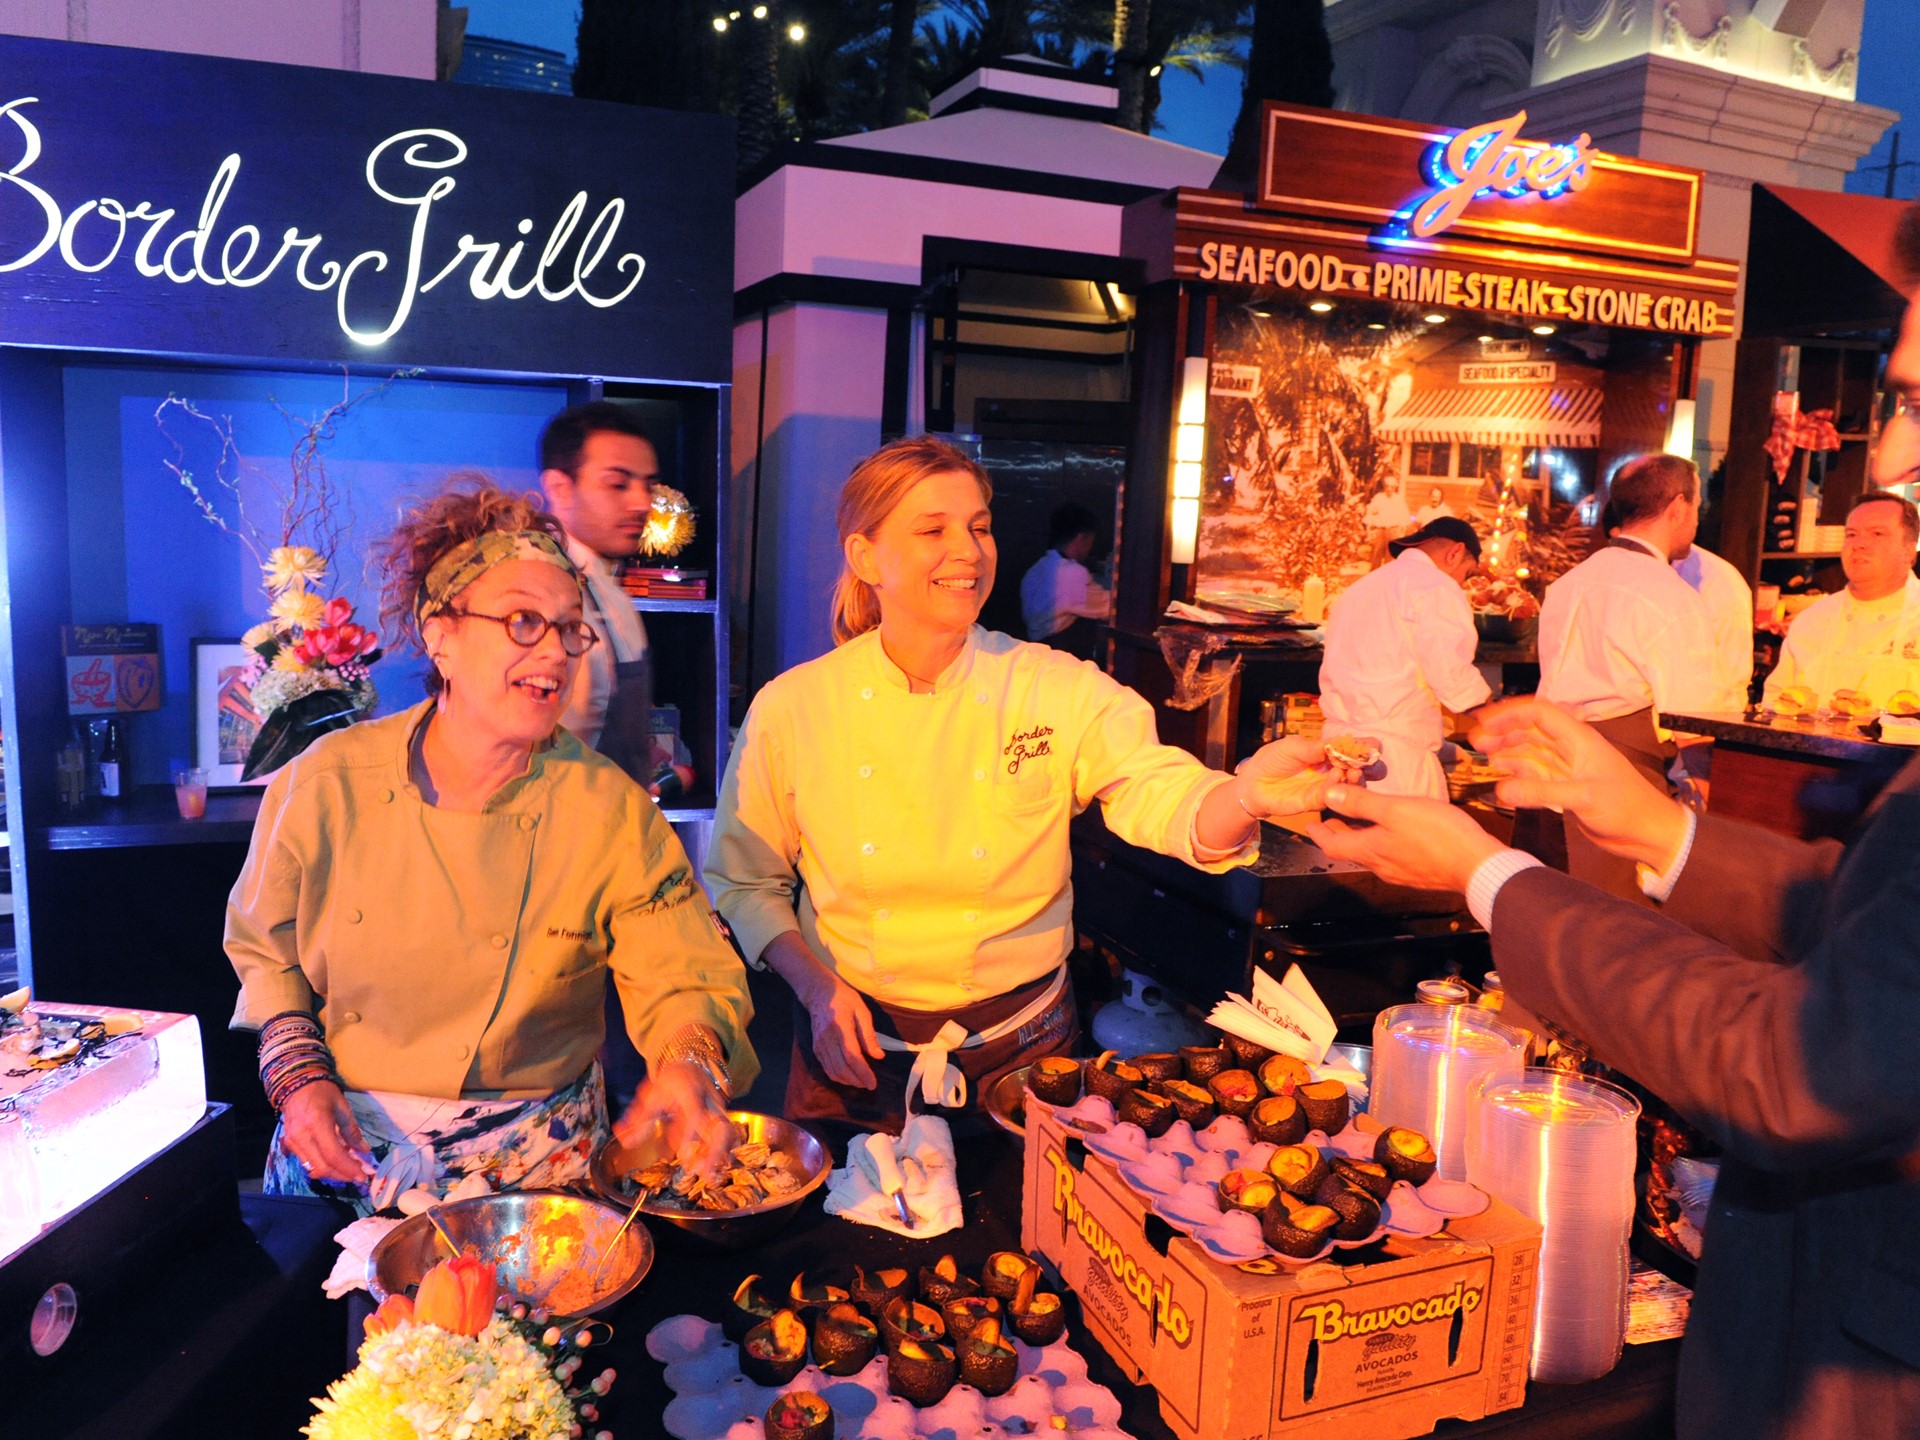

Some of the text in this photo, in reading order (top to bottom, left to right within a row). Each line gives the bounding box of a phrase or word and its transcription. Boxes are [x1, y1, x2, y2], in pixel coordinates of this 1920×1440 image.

[1413, 109, 1600, 238] Joe's
[0, 96, 646, 346] Border Grill
[1199, 241, 1719, 334] SEAFOOD PRIME STEAK STONE CRAB
[1506, 364, 1552, 380] SPECIALTY
[1007, 740, 1050, 775] Grill
[1045, 1145, 1193, 1346] Bravocado
[1511, 1274, 1521, 1286] 32
[1083, 1284, 1132, 1347] AVOCADOS
[1241, 1298, 1273, 1312] Produce
[1251, 1313, 1261, 1324] of
[1297, 1282, 1482, 1342] Bravocado
[1243, 1326, 1266, 1339] U.S.A.
[1354, 1350, 1419, 1374] AVOCADOS
